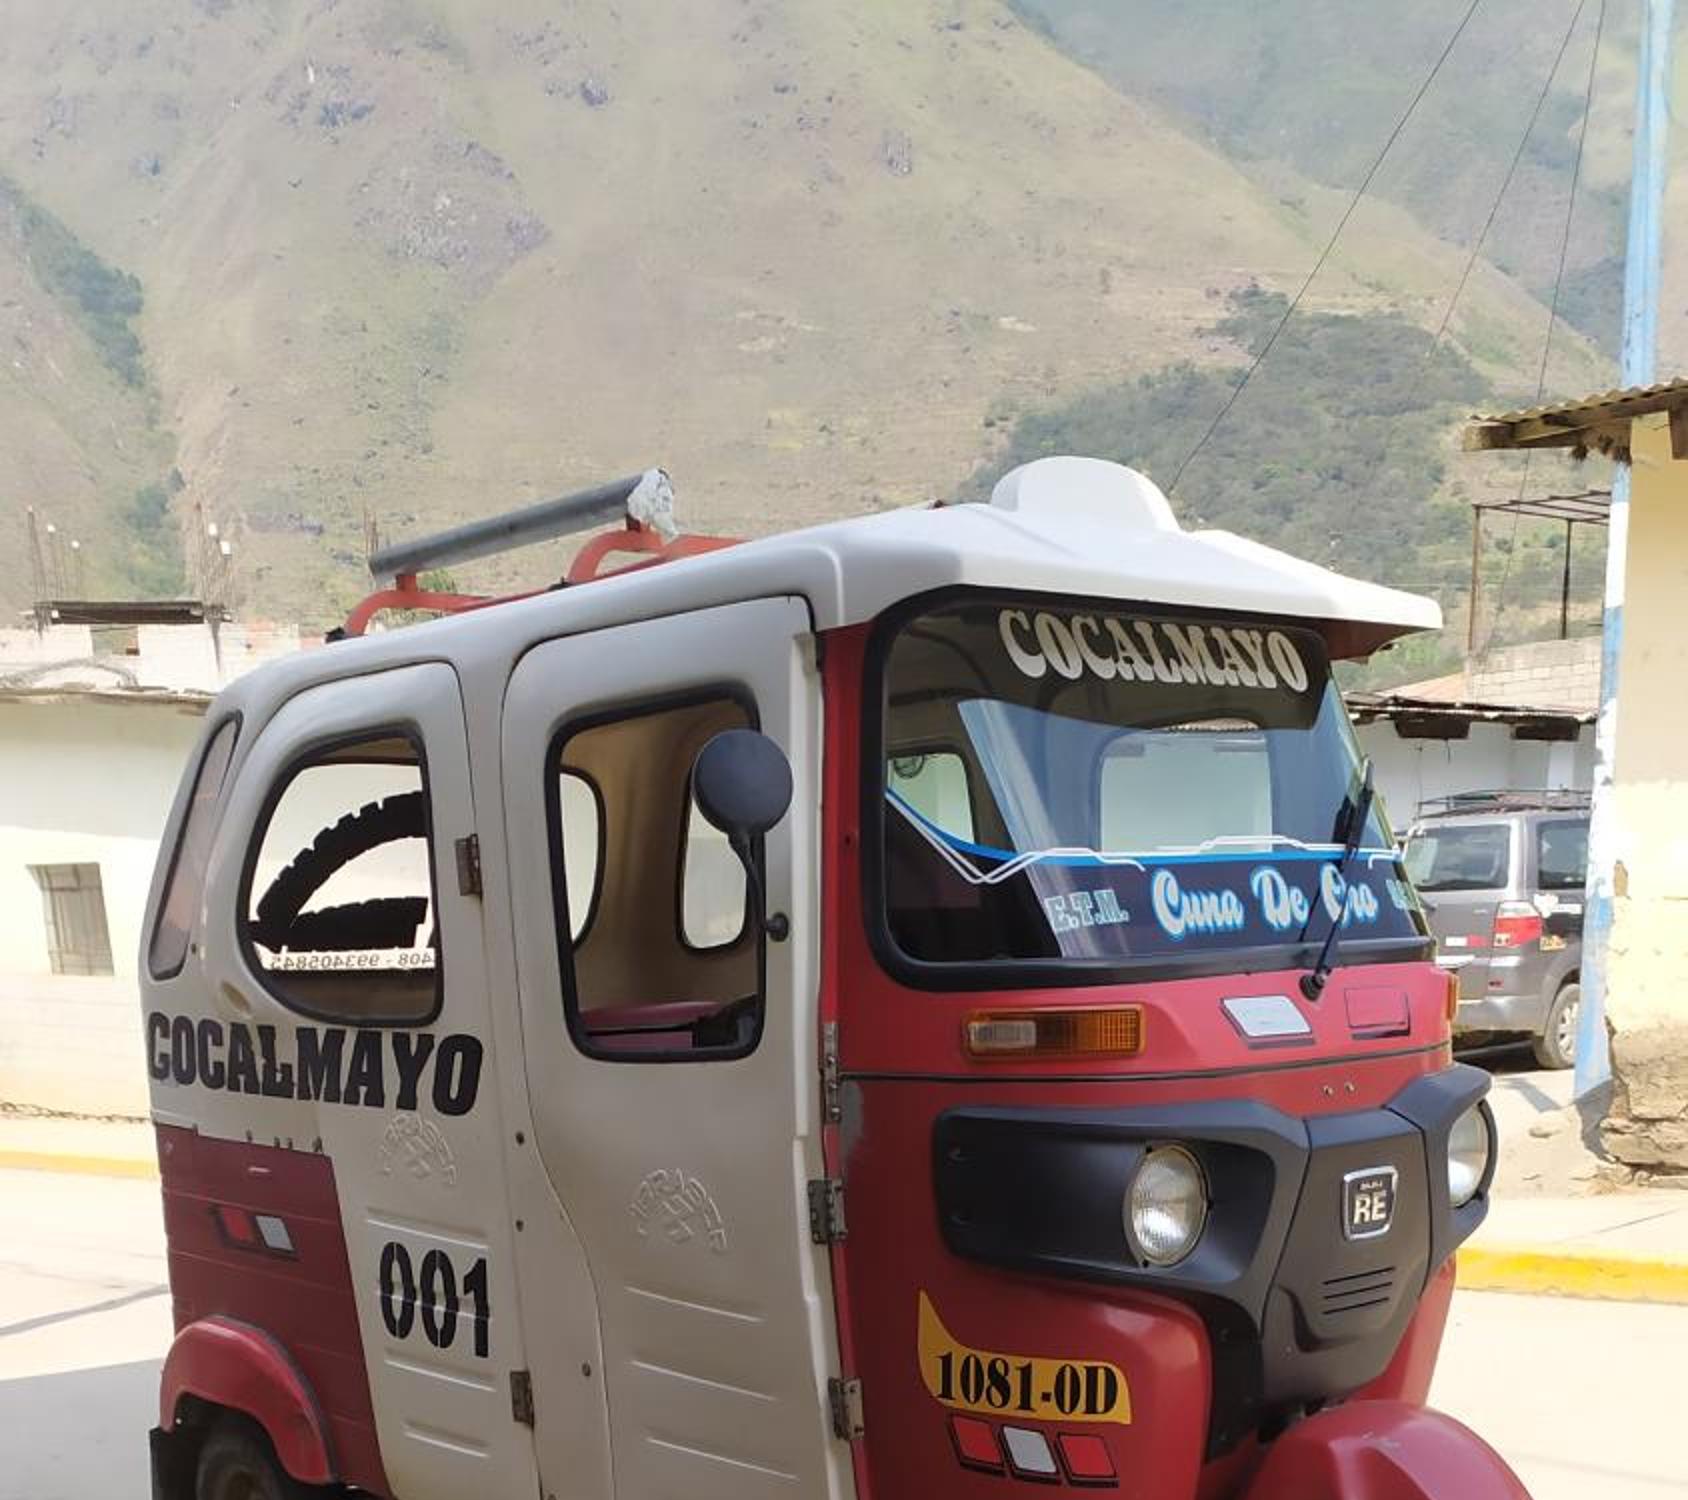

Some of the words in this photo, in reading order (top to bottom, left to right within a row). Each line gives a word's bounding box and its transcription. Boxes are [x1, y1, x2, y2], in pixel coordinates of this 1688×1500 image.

[999, 608, 1309, 693] COCALMAYO
[1152, 868, 1245, 937] Cuna
[1251, 867, 1310, 931] De
[149, 1011, 484, 1117] COCALMAYO
[1353, 1190, 1387, 1225] RE
[379, 1241, 491, 1359] 001
